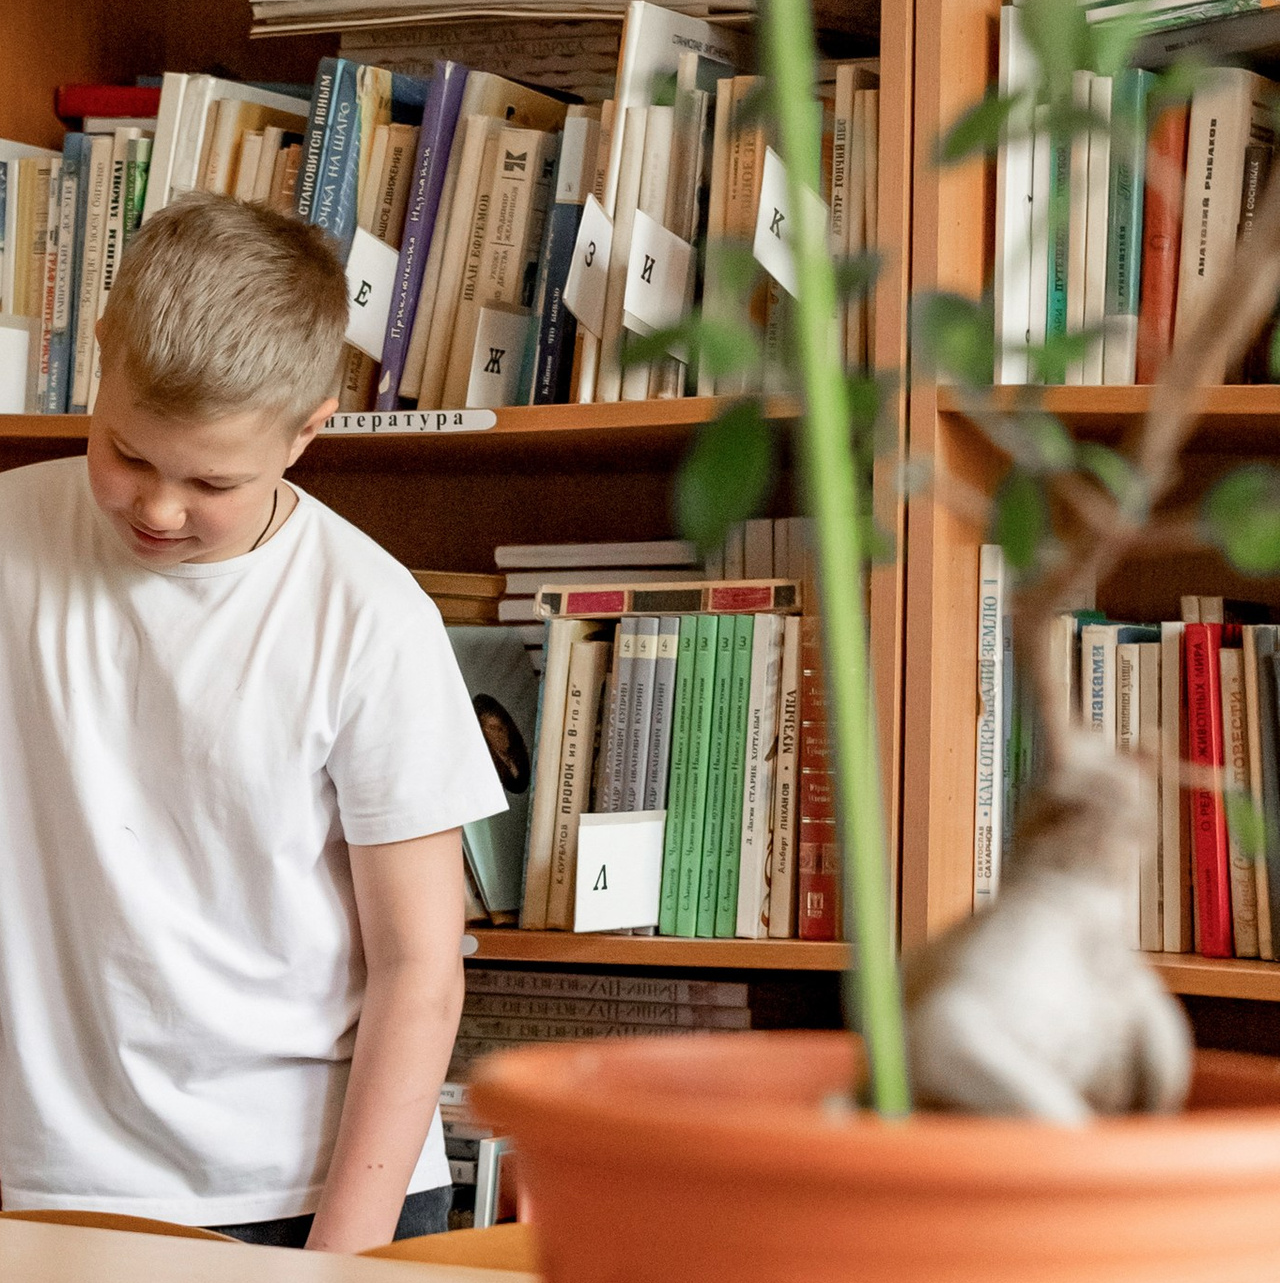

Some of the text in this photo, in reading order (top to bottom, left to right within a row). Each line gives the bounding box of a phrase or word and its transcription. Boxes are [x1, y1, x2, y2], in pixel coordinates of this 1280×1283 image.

[297, 74, 333, 215] СТАНОВИТСЯ ЯВНЫМ
[835, 118, 846, 140] ПЕС
[324, 152, 343, 178] НА
[382, 145, 403, 205] ДВИЖЕНИЕ
[769, 207, 784, 239] К
[1193, 118, 1219, 276] АНАТОЛИЙ РЫБАКОВ
[81, 257, 98, 308] Зоопарк
[90, 161, 105, 207] багаже
[103, 228, 116, 290] ИМЕНЕМ
[389, 146, 436, 339] Приключения Незнайки
[462, 192, 490, 301] ИВАН ЕФРЕМОВ
[584, 241, 595, 267] З
[353, 280, 371, 306] Е
[640, 254, 655, 283] И
[40, 250, 58, 374] ГРАФ МОНТЕ-КРИСТО
[483, 347, 505, 374] Ж
[684, 637, 691, 649] 3
[700, 637, 708, 648] 3
[722, 636, 729, 647] 3
[738, 635, 746, 647] 3
[981, 594, 997, 657] ЗЕМЛЮ
[1193, 641, 1204, 674] МИРА
[613, 682, 627, 782] ИВАНОВИЧ КУПРИН
[629, 682, 644, 783] ИВАНОВИЧ КУПРИН
[650, 682, 665, 783] ИВАНОВИЧ КУПРИН
[1194, 682, 1208, 756] ЖИВОТНЫХ
[560, 763, 575, 813] ПРОРОК
[746, 707, 760, 831] Лагин СТАРИК ХОТТАБЫЧ
[777, 688, 798, 873] Альберт ЛИХАНОВ МУЗЫКА
[978, 772, 993, 807] КАК
[556, 823, 568, 873] КУРБАТОВ
[976, 825, 985, 877] СВЯТОСЛАВ
[984, 824, 992, 878] САХАРНОВ
[593, 863, 607, 890] Л
